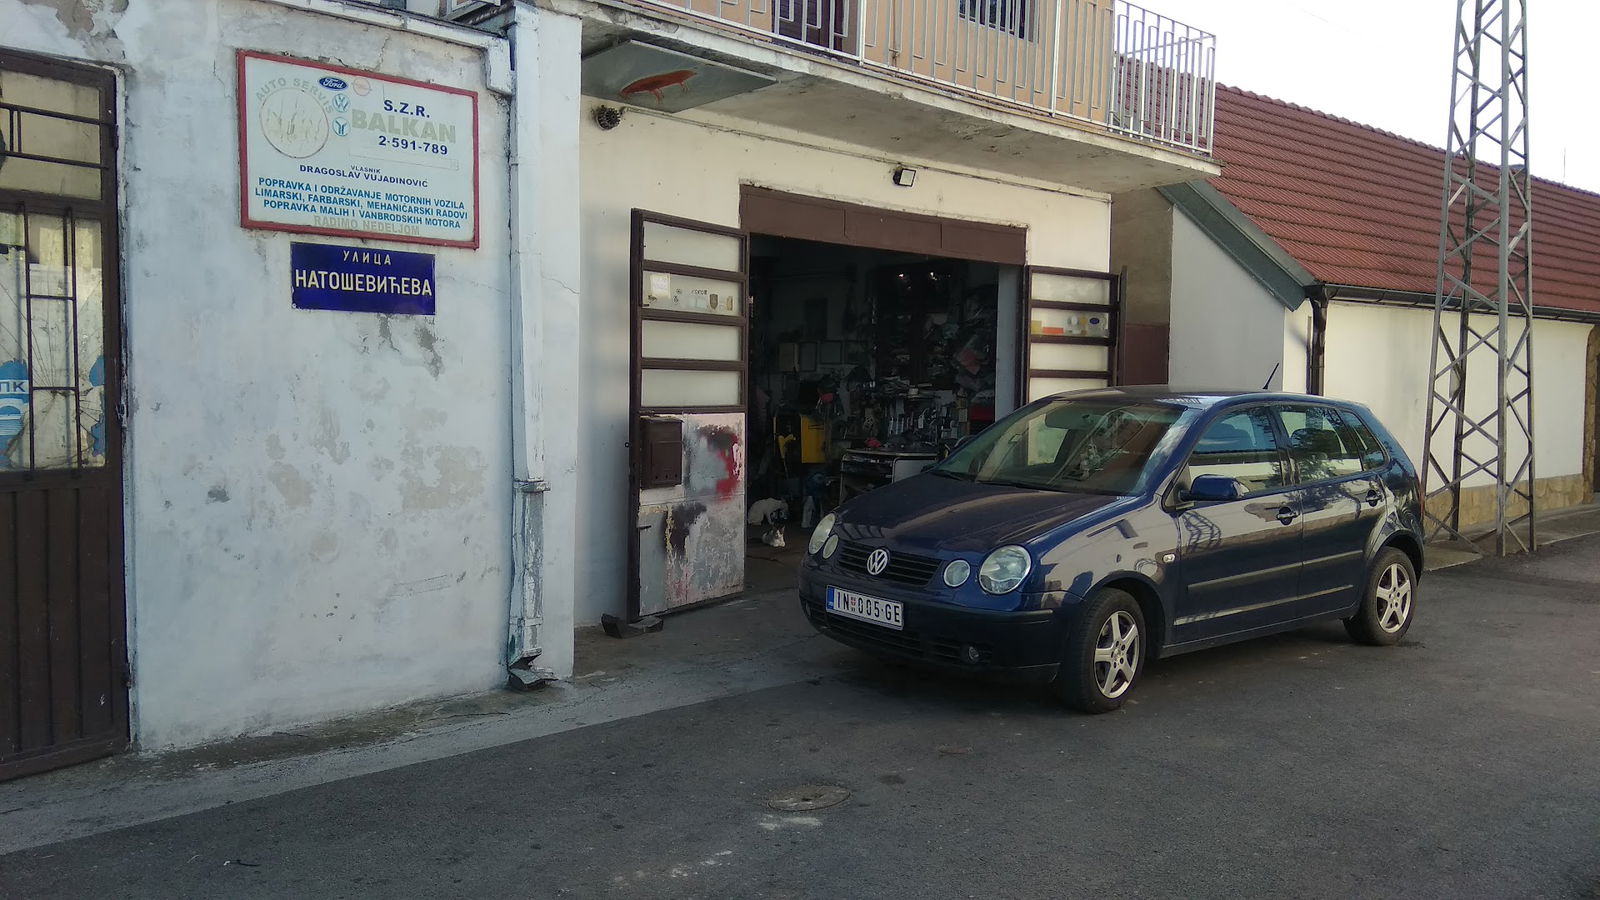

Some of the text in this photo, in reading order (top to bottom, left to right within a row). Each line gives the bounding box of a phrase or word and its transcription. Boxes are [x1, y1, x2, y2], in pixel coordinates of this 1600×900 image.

[256, 77, 334, 114] AUTO SERVIS
[321, 77, 345, 89] Ford
[383, 99, 430, 118] S.Z.R.
[352, 109, 456, 144] BALKAN
[299, 164, 429, 188] DRAGOSLAV VUJADINOVIĆ
[350, 164, 381, 174] VLASNIK
[255, 187, 305, 203] LIMARSKI,
[308, 193, 363, 209] FARBARSKI,
[436, 208, 468, 220] RADOVI
[258, 177, 312, 192] POPRAVKA
[320, 184, 381, 200] ODRŽAVANJE
[385, 192, 432, 206] MOTORNIH
[434, 198, 465, 210] VOZILA
[263, 199, 317, 213] POPRAVKA
[320, 205, 349, 217] MALIH
[359, 209, 422, 225] VANBRODSKIH
[425, 217, 461, 229] MOTORA
[314, 215, 420, 236] RADIMO NEDELJOM
[343, 250, 392, 265] УЛИЦА
[295, 269, 432, 297] НАТОШЕВИЋЕВА
